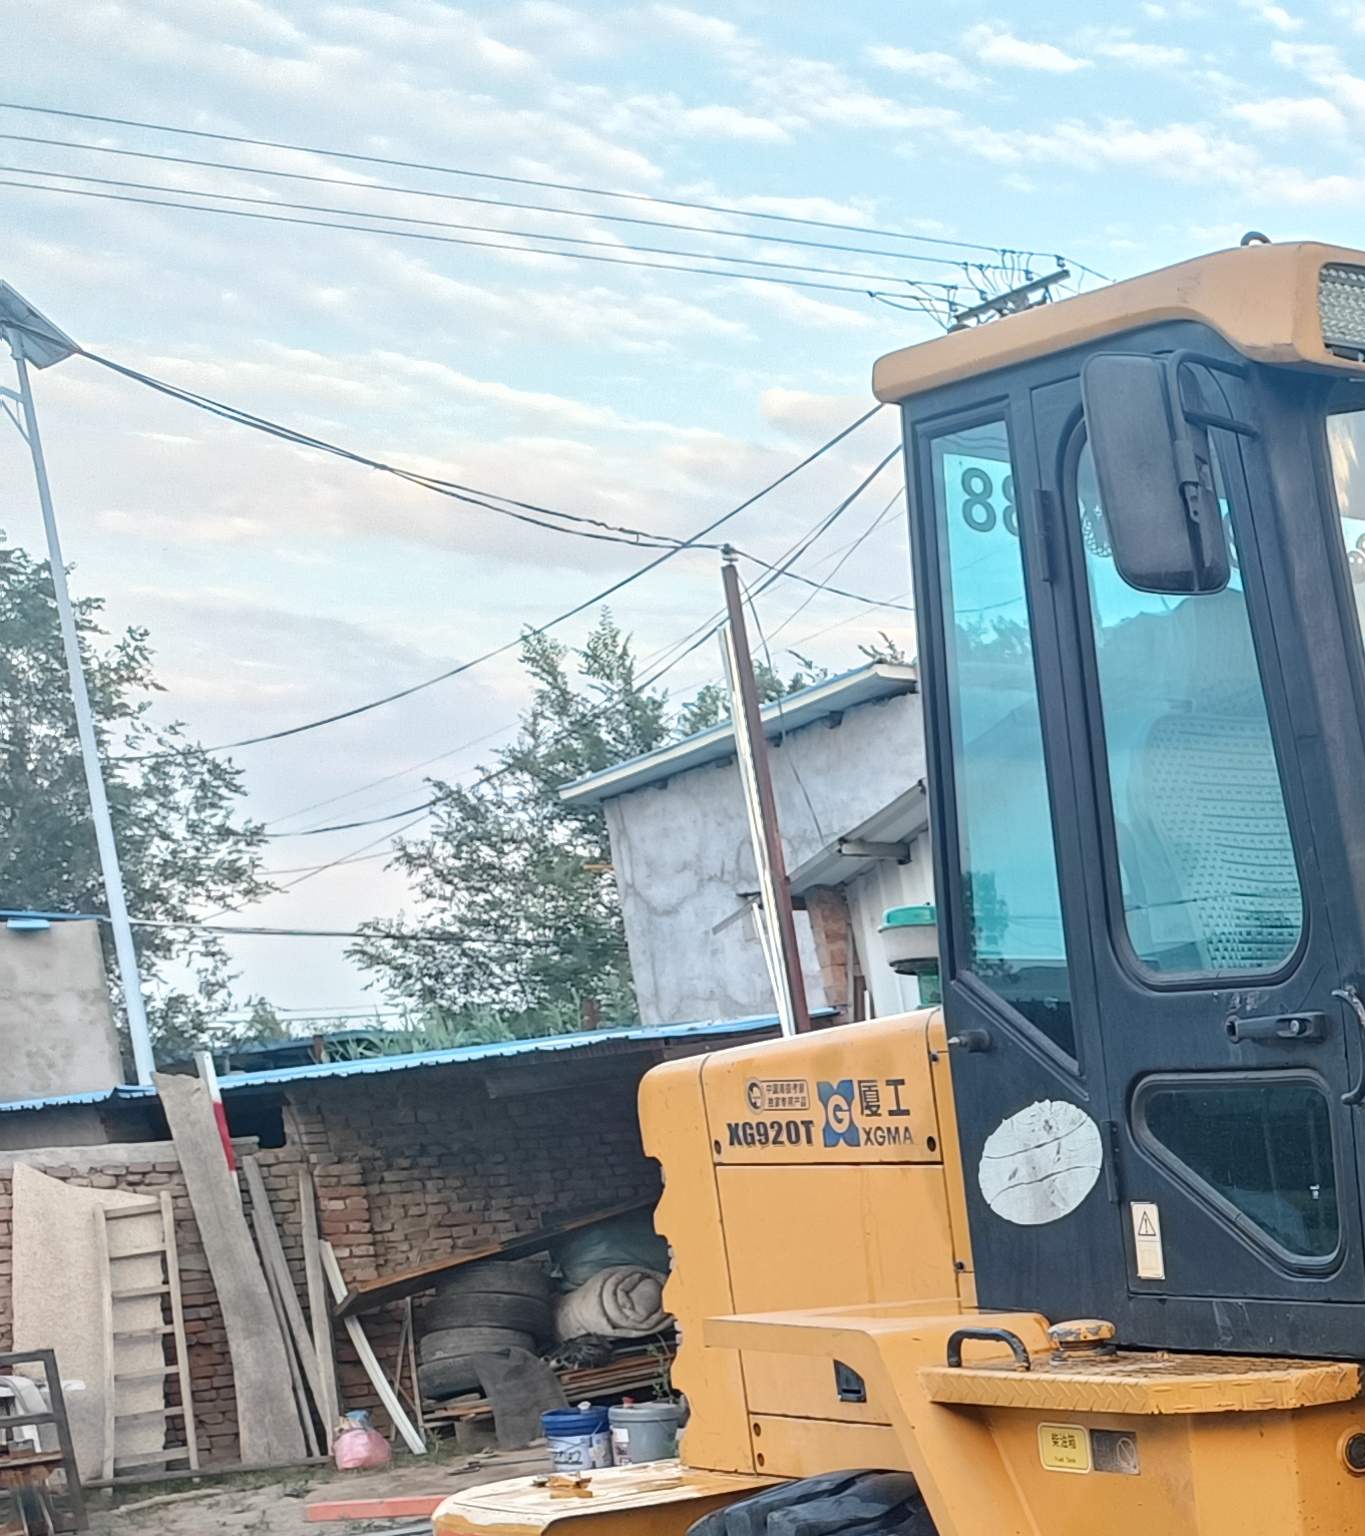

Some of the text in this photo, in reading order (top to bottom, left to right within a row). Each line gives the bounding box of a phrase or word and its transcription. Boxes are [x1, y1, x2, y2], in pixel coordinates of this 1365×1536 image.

[857, 1078, 911, 1117] 厦工
[727, 1120, 815, 1147] XG920T
[861, 1126, 914, 1146] XGMA
